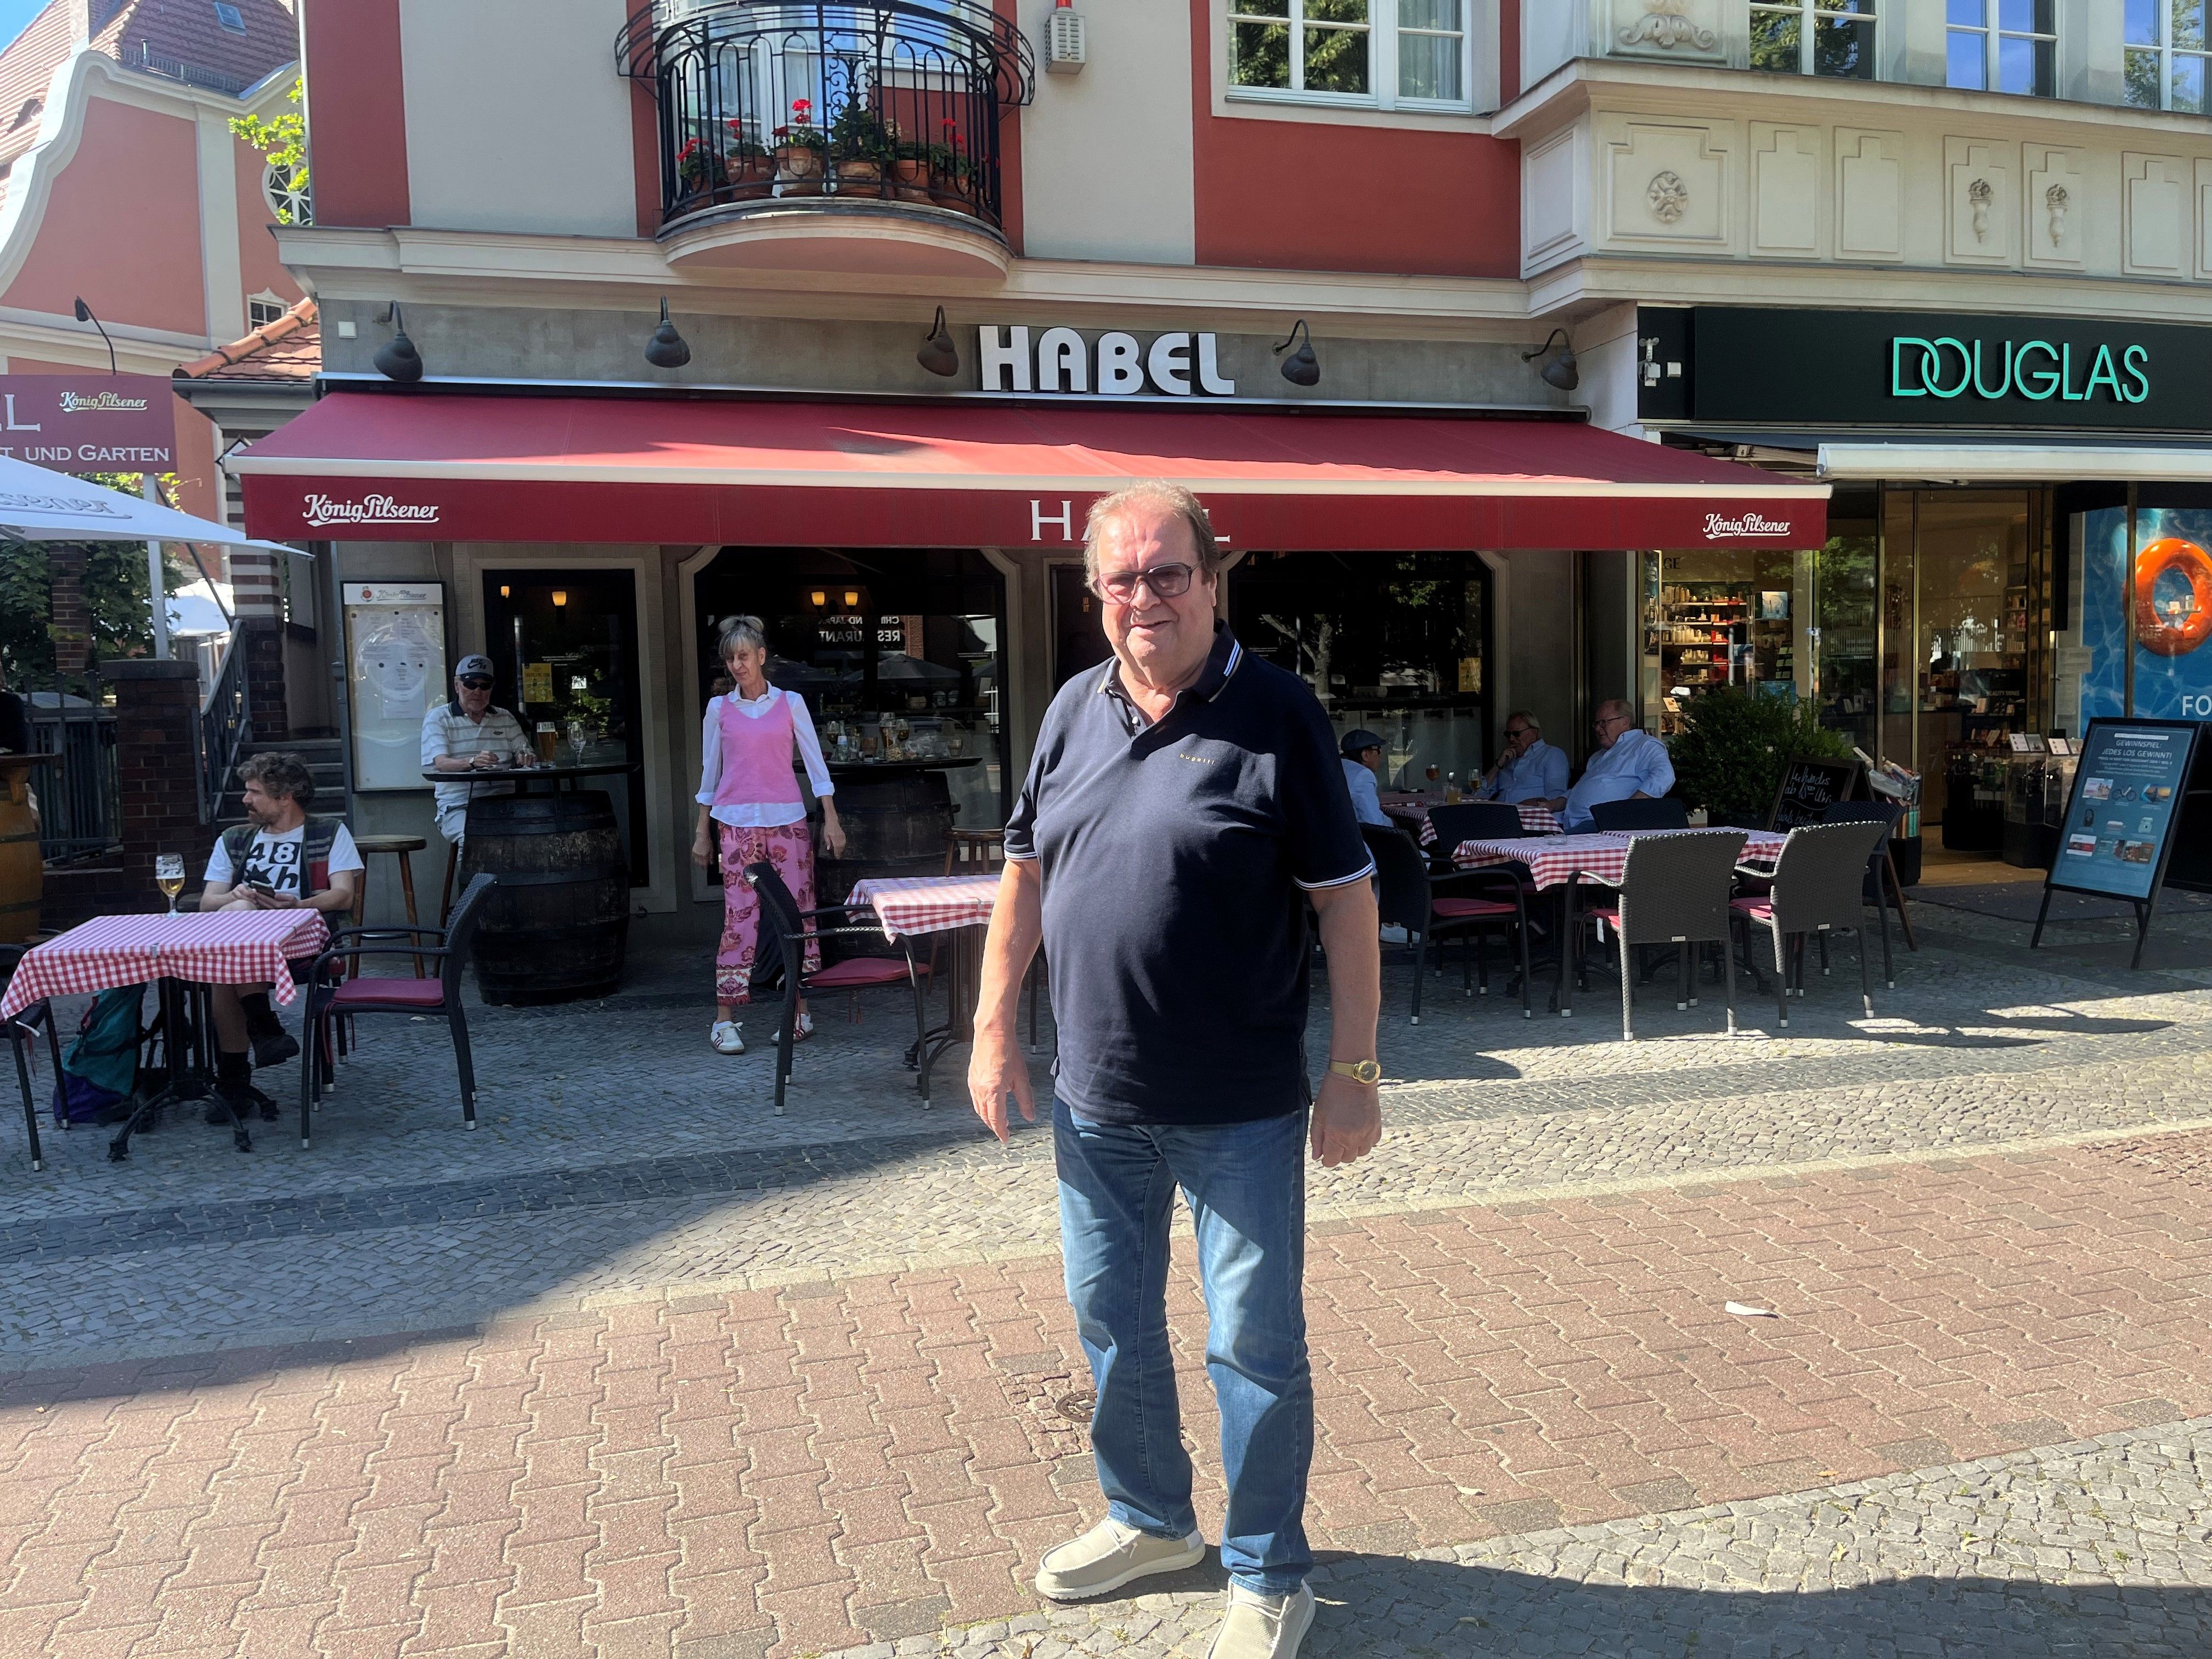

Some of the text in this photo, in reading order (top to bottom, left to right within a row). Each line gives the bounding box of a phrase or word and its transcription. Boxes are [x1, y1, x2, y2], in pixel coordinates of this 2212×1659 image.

[979, 325, 1235, 396] HABEL
[1892, 336, 2149, 404] DOUGLAS
[59, 391, 148, 410] König Pilsener
[302, 493, 439, 523] König Pilsener
[1702, 512, 1791, 536] König Pilsener
[1180, 753, 1215, 765] bugatti
[247, 842, 296, 864] 48
